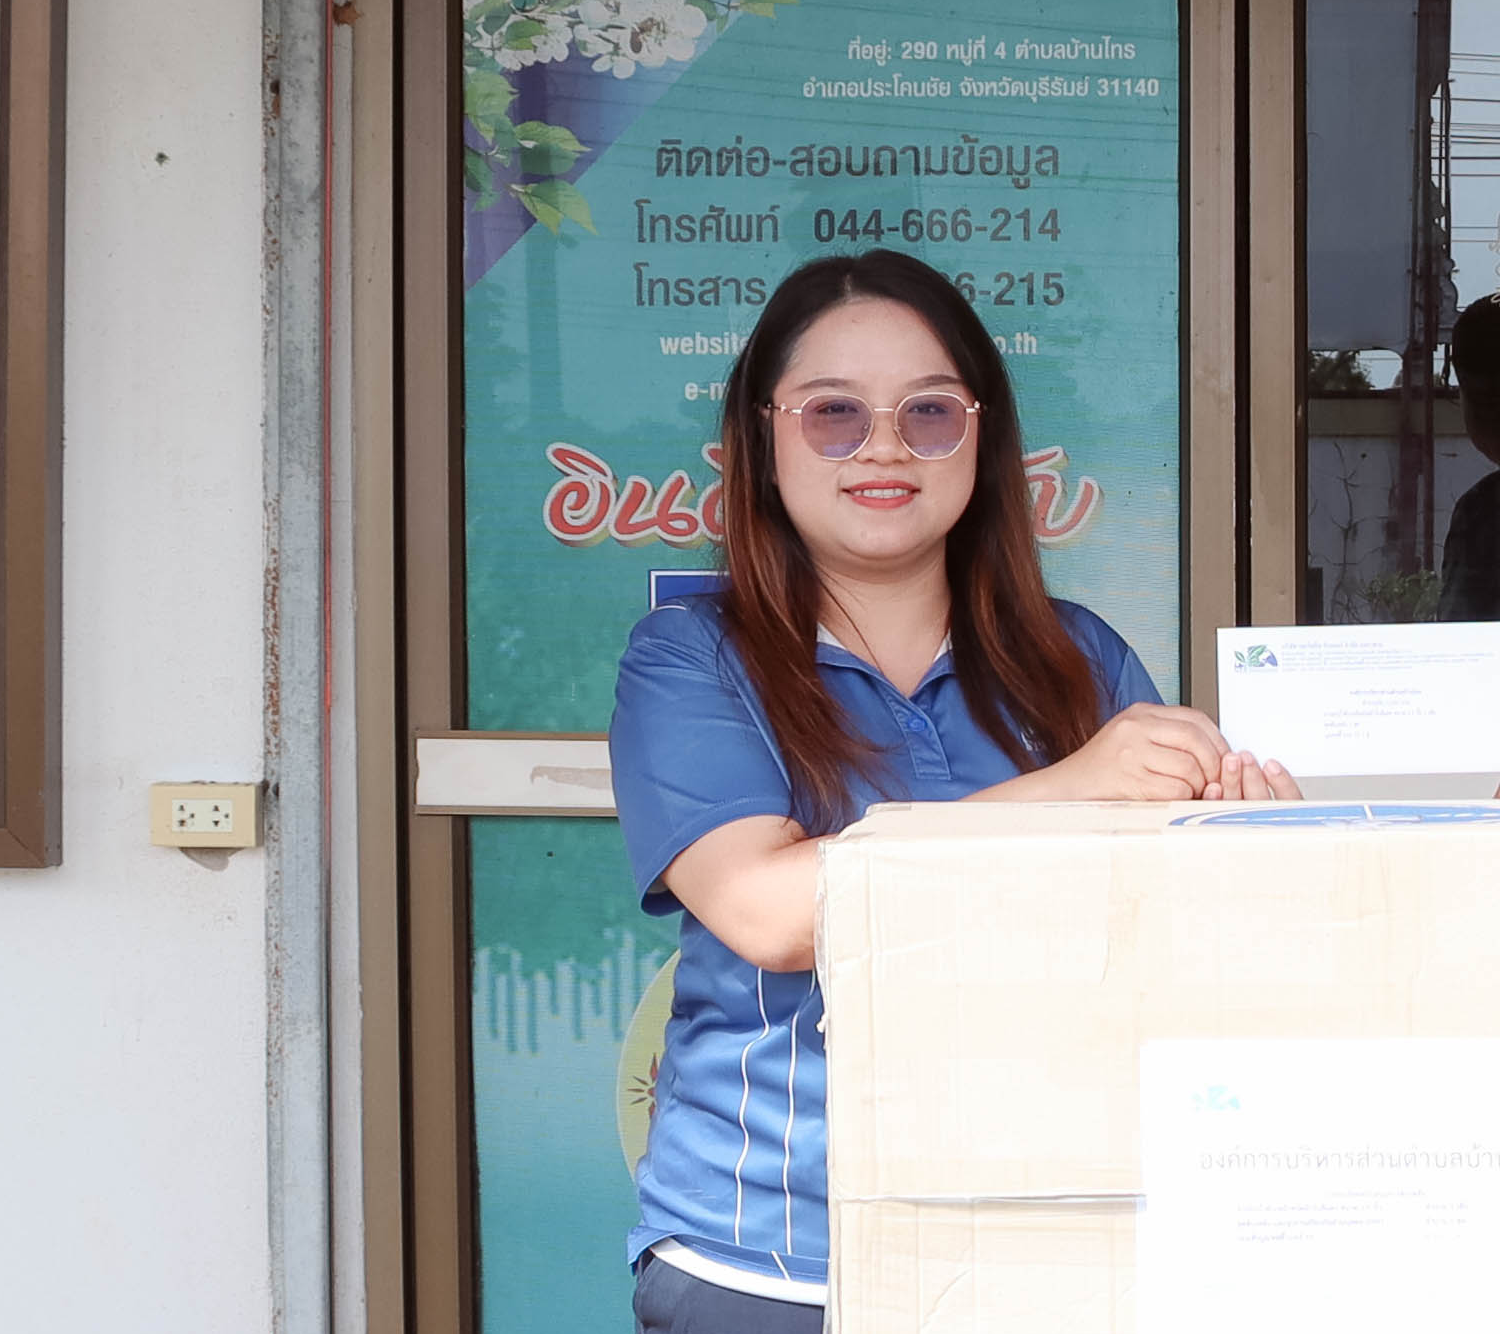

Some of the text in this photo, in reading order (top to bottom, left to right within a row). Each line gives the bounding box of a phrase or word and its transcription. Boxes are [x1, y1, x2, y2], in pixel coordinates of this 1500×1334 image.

[901, 40, 938, 60] 290
[945, 34, 988, 65] หมู่ที่
[993, 40, 1007, 60] 4
[1014, 34, 1137, 62] ตำบลบ้านไทร
[802, 72, 1160, 103] อำเภอประโคนชัย จังหวัดบุรีรัมย์ 31140
[654, 133, 1061, 190] ติดต่อ-สอบถามข้อมูล
[634, 199, 1063, 244] โทรศัพท์ 044-666-214
[634, 265, 768, 307] โทรสาร
